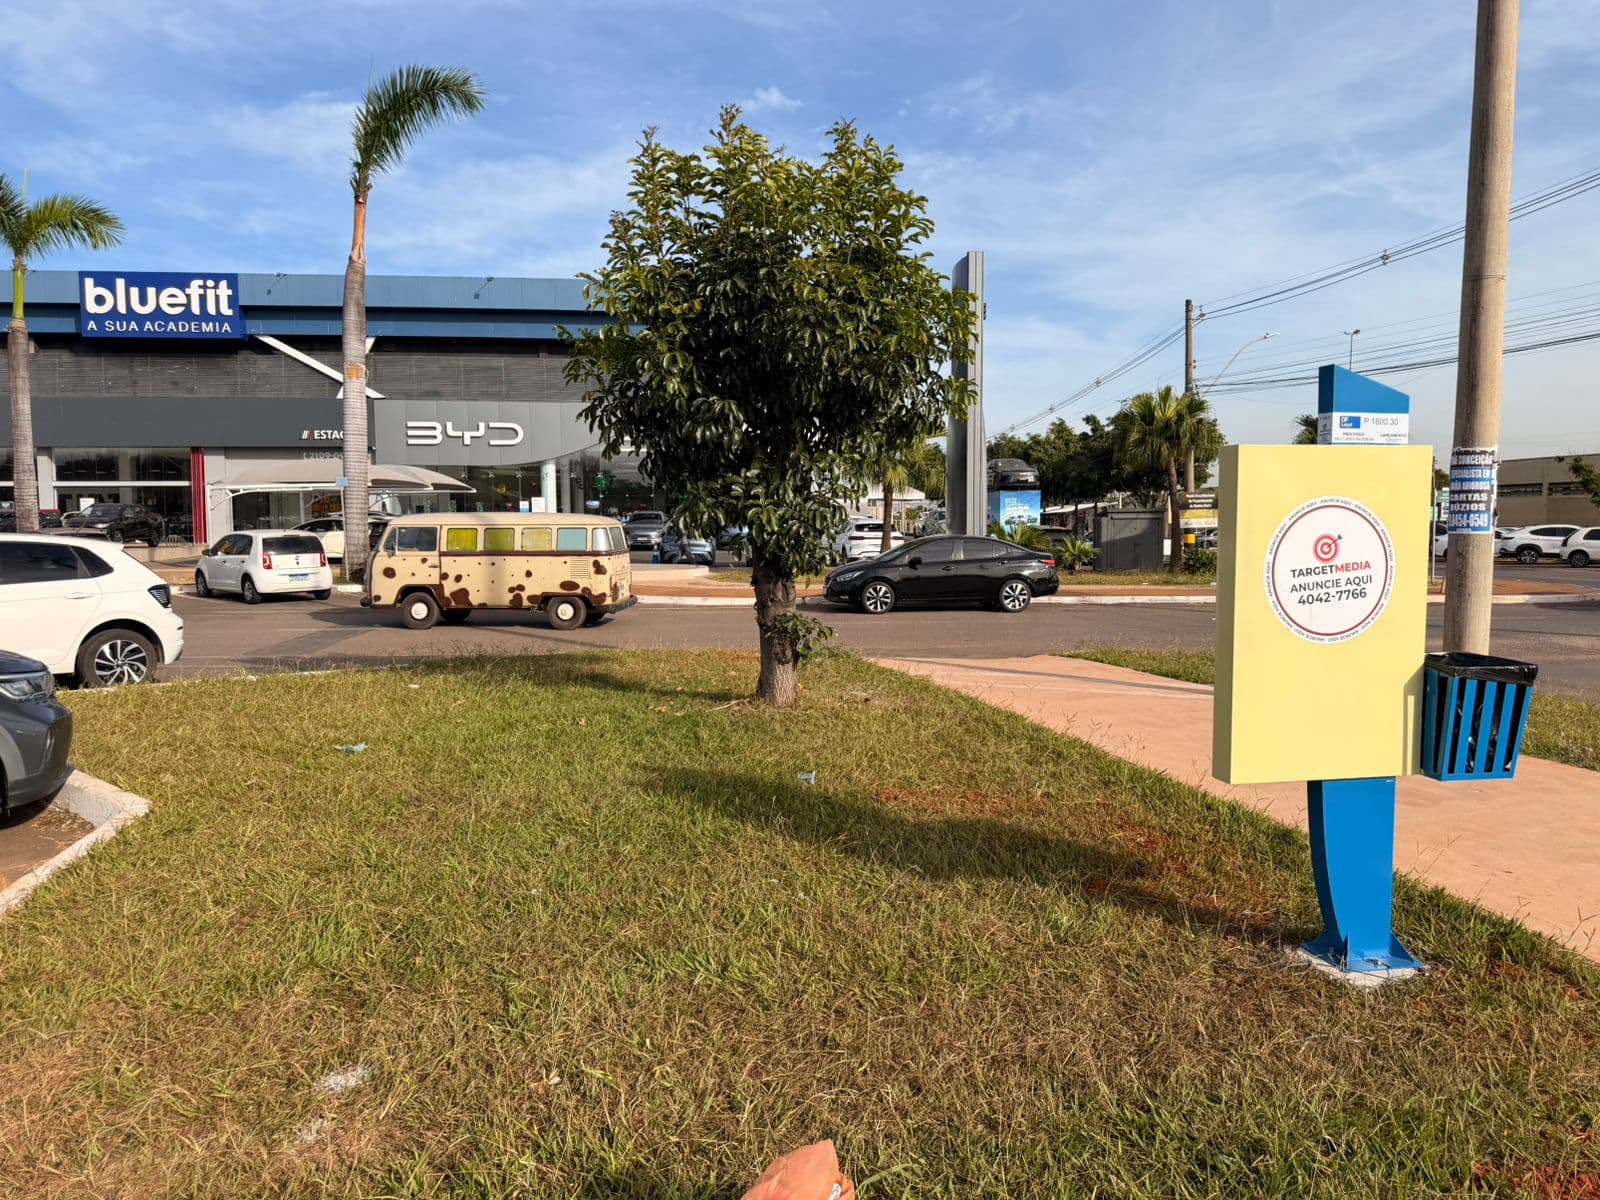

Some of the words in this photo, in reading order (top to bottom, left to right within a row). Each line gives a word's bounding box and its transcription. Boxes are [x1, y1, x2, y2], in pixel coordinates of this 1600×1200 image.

[84, 277, 234, 316] bluefit
[87, 320, 98, 332] A
[105, 320, 139, 332] SUA
[144, 321, 232, 333] ACADEMIA
[1372, 417, 1399, 426] 1600.30
[406, 421, 524, 446] BYD
[1450, 493, 1488, 502] CARTAS
[1290, 560, 1372, 579] TARGETMEDIA
[1290, 578, 1342, 594] ANUNCIE
[1344, 574, 1373, 588] AQUI
[1297, 587, 1367, 606] 4042-7766
